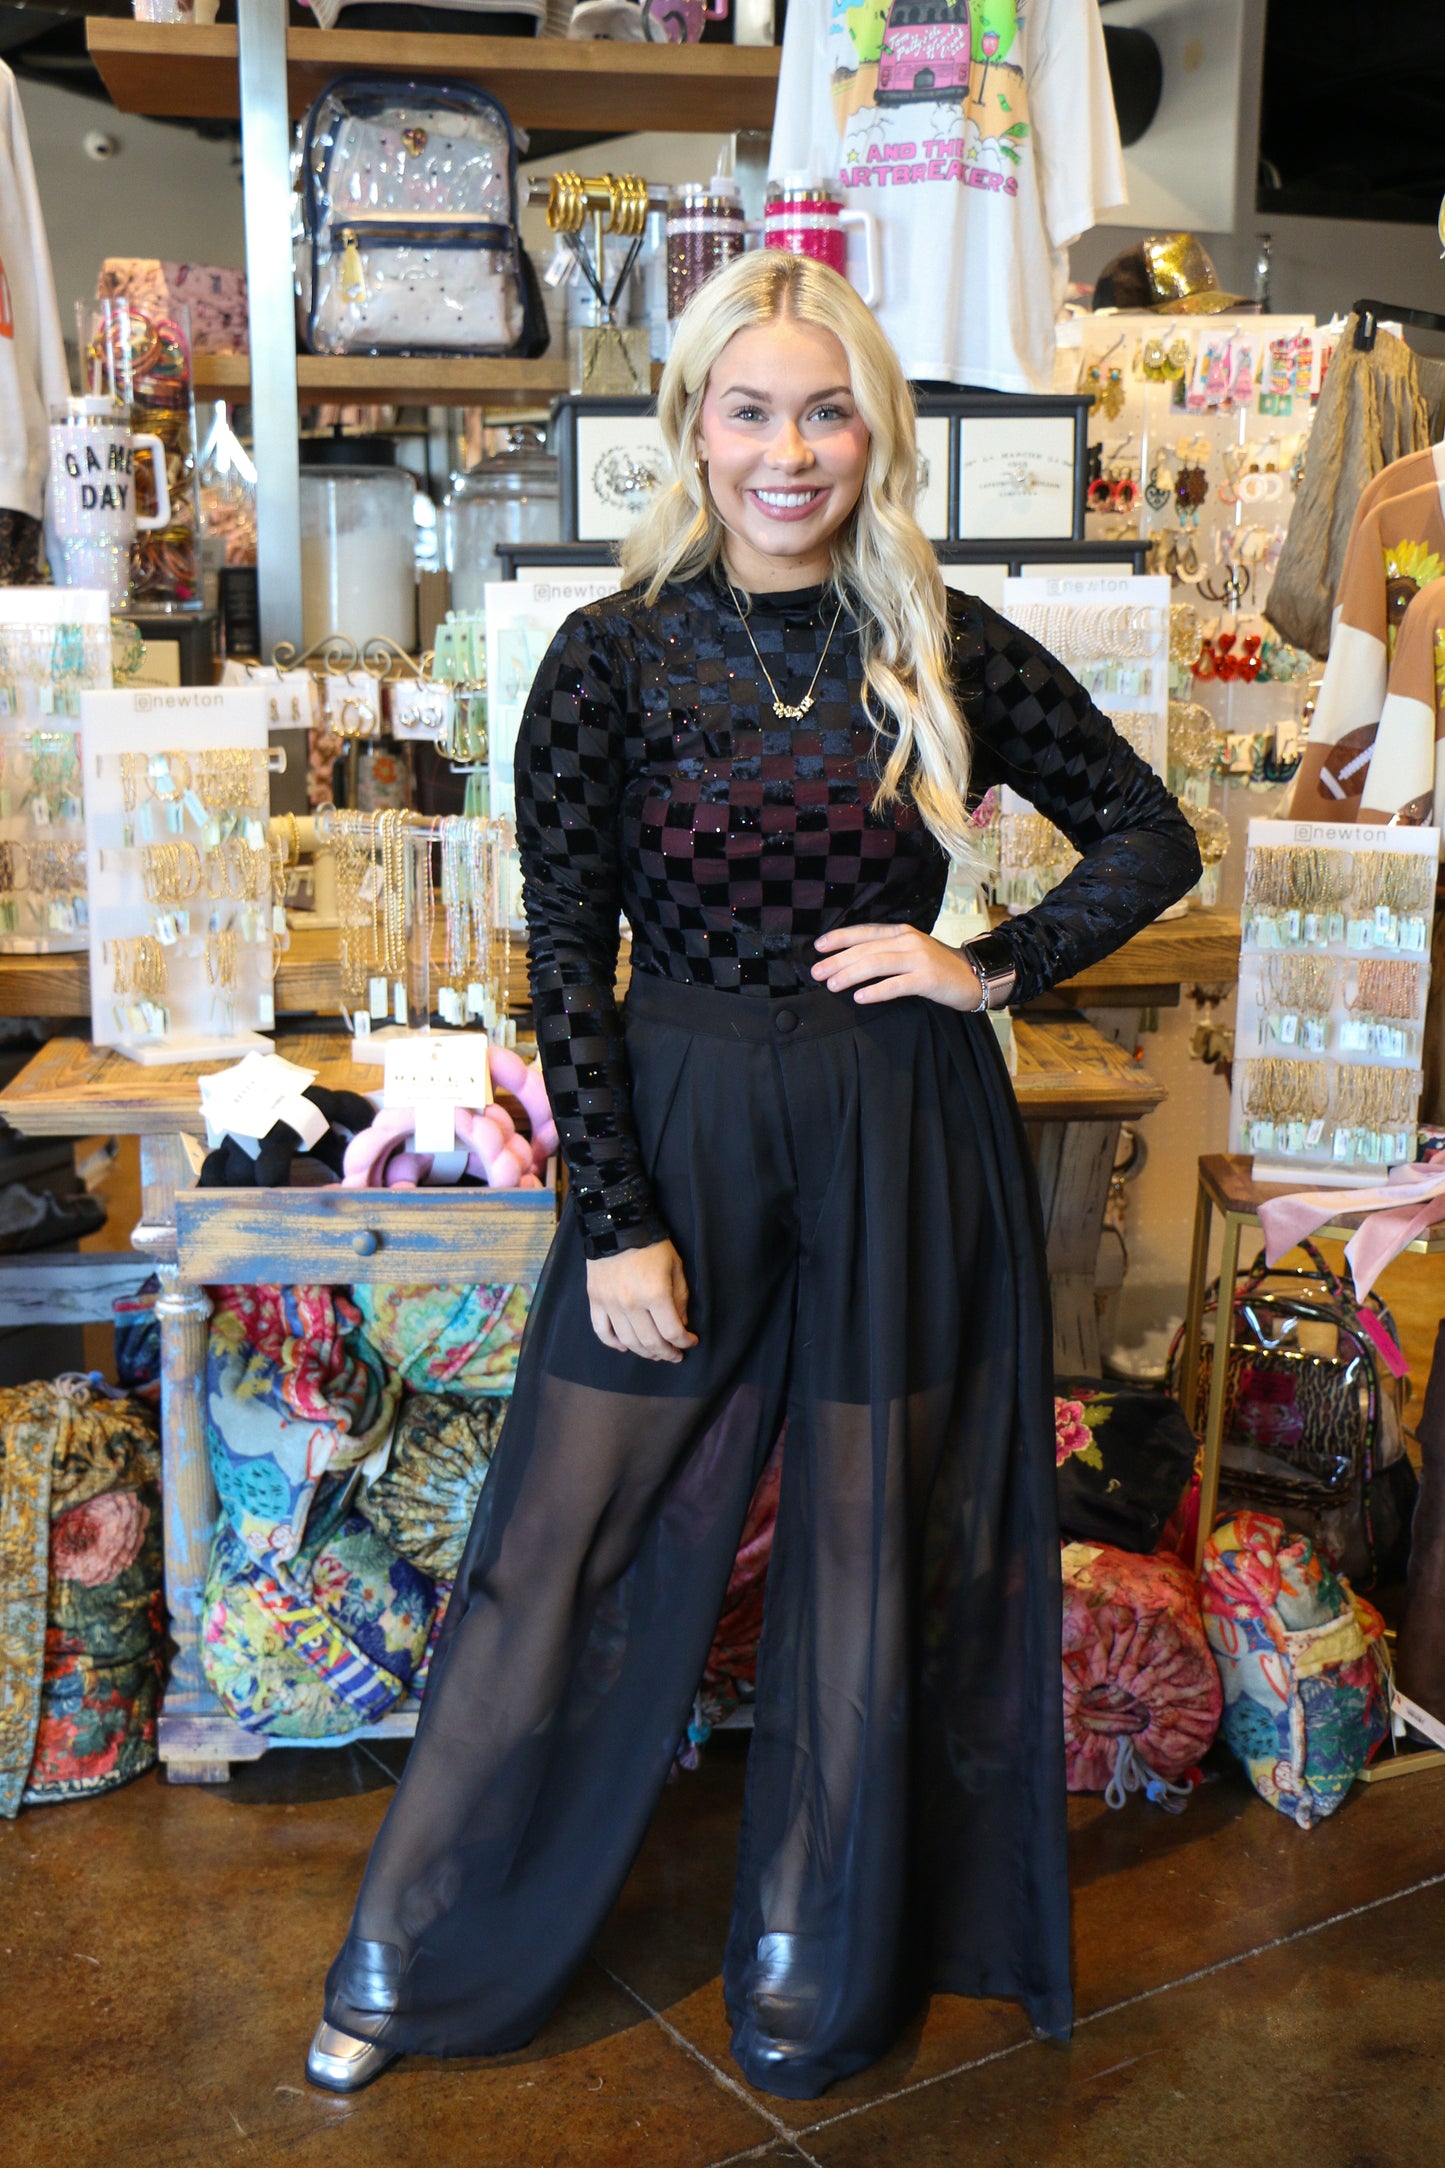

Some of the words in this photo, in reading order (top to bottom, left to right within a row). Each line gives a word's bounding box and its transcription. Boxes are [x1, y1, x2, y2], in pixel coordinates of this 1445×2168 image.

[866, 142, 917, 163] AND
[839, 159, 1019, 197] ARTBREAKERS
[81, 484, 128, 511] DAY
